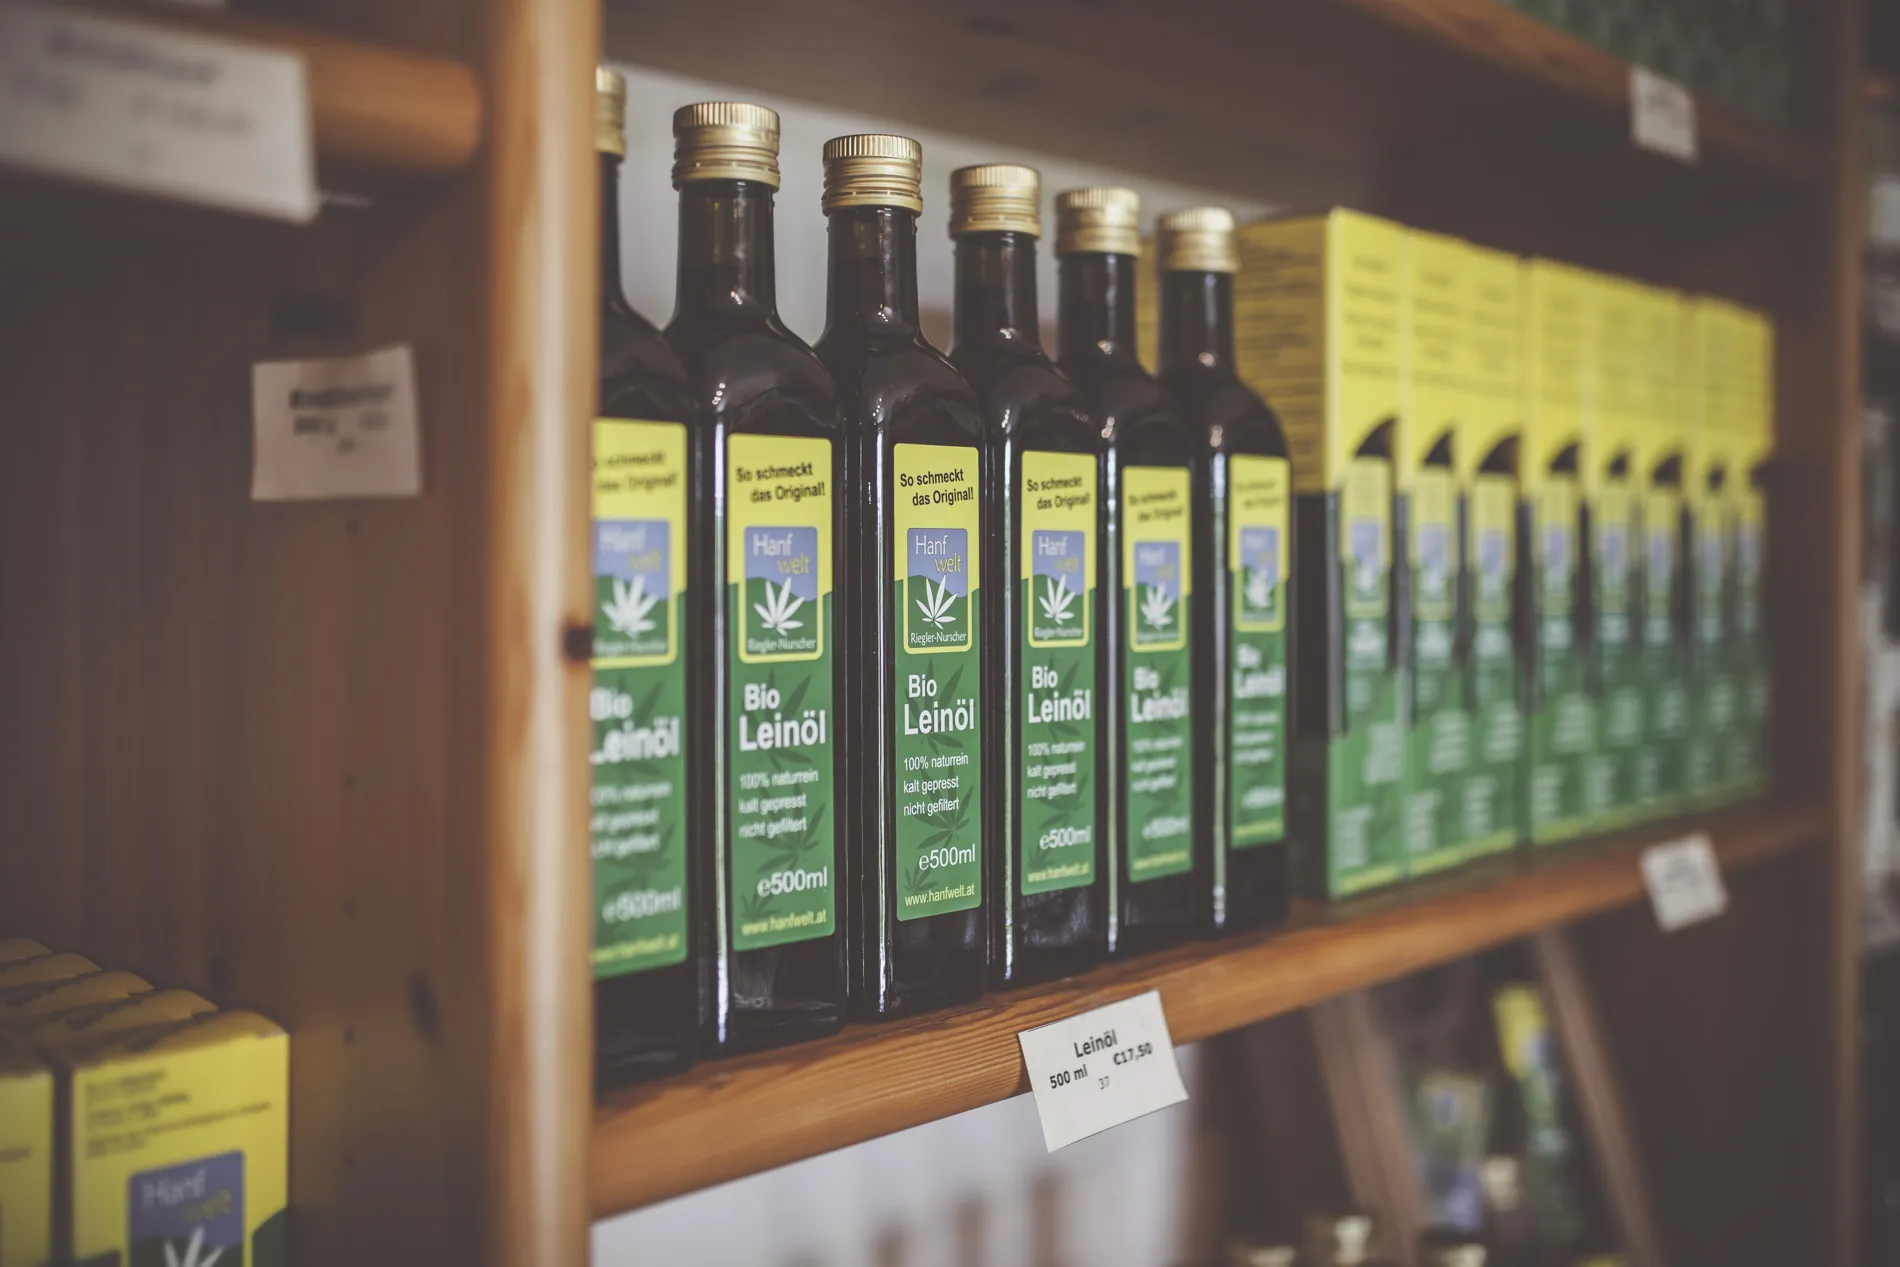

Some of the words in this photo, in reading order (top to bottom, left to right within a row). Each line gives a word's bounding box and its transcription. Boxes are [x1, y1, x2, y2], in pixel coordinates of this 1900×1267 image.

[735, 467, 752, 482] So
[756, 462, 813, 480] schmeckt
[900, 473, 914, 487] So
[916, 468, 964, 487] schmeckt
[750, 486, 772, 503] das
[775, 481, 825, 502] Original!
[1027, 479, 1039, 492] So
[1041, 476, 1083, 491] schmeckt
[912, 492, 931, 507] das
[933, 487, 974, 506] Original!
[1037, 497, 1053, 510] das
[753, 533, 793, 556] Hanf
[915, 535, 948, 555] Hanf
[1038, 536, 1068, 556] Hanf
[777, 553, 811, 574] welt
[934, 553, 962, 572] welt
[910, 632, 967, 646] Riegler-Nurscher
[908, 674, 937, 698] Bio
[1032, 666, 1058, 689] Bio
[744, 683, 780, 711] Bio
[1028, 690, 1091, 724] Leinöl
[904, 699, 975, 735] Leinöl
[739, 709, 826, 751] Leinöl
[904, 756, 929, 771] 100%
[931, 752, 969, 769] naturrein
[740, 772, 770, 789] 100%
[772, 768, 819, 787] naturrein
[903, 779, 920, 794] kalt
[922, 776, 959, 795] gepresst
[739, 797, 759, 814] kalt
[760, 794, 807, 816] gepresst
[903, 801, 925, 817] nicht
[927, 798, 959, 816] gefiltert
[739, 821, 766, 838] nicht
[767, 817, 807, 839] gefiltert
[905, 883, 975, 907] www.hanfwelt.at
[741, 909, 827, 936] www.hanfwelt.at
[1073, 1029, 1118, 1058] Leinöl
[1050, 1070, 1071, 1089] 500
[1074, 1064, 1088, 1081] ml
[1098, 1076, 1110, 1090] 37
